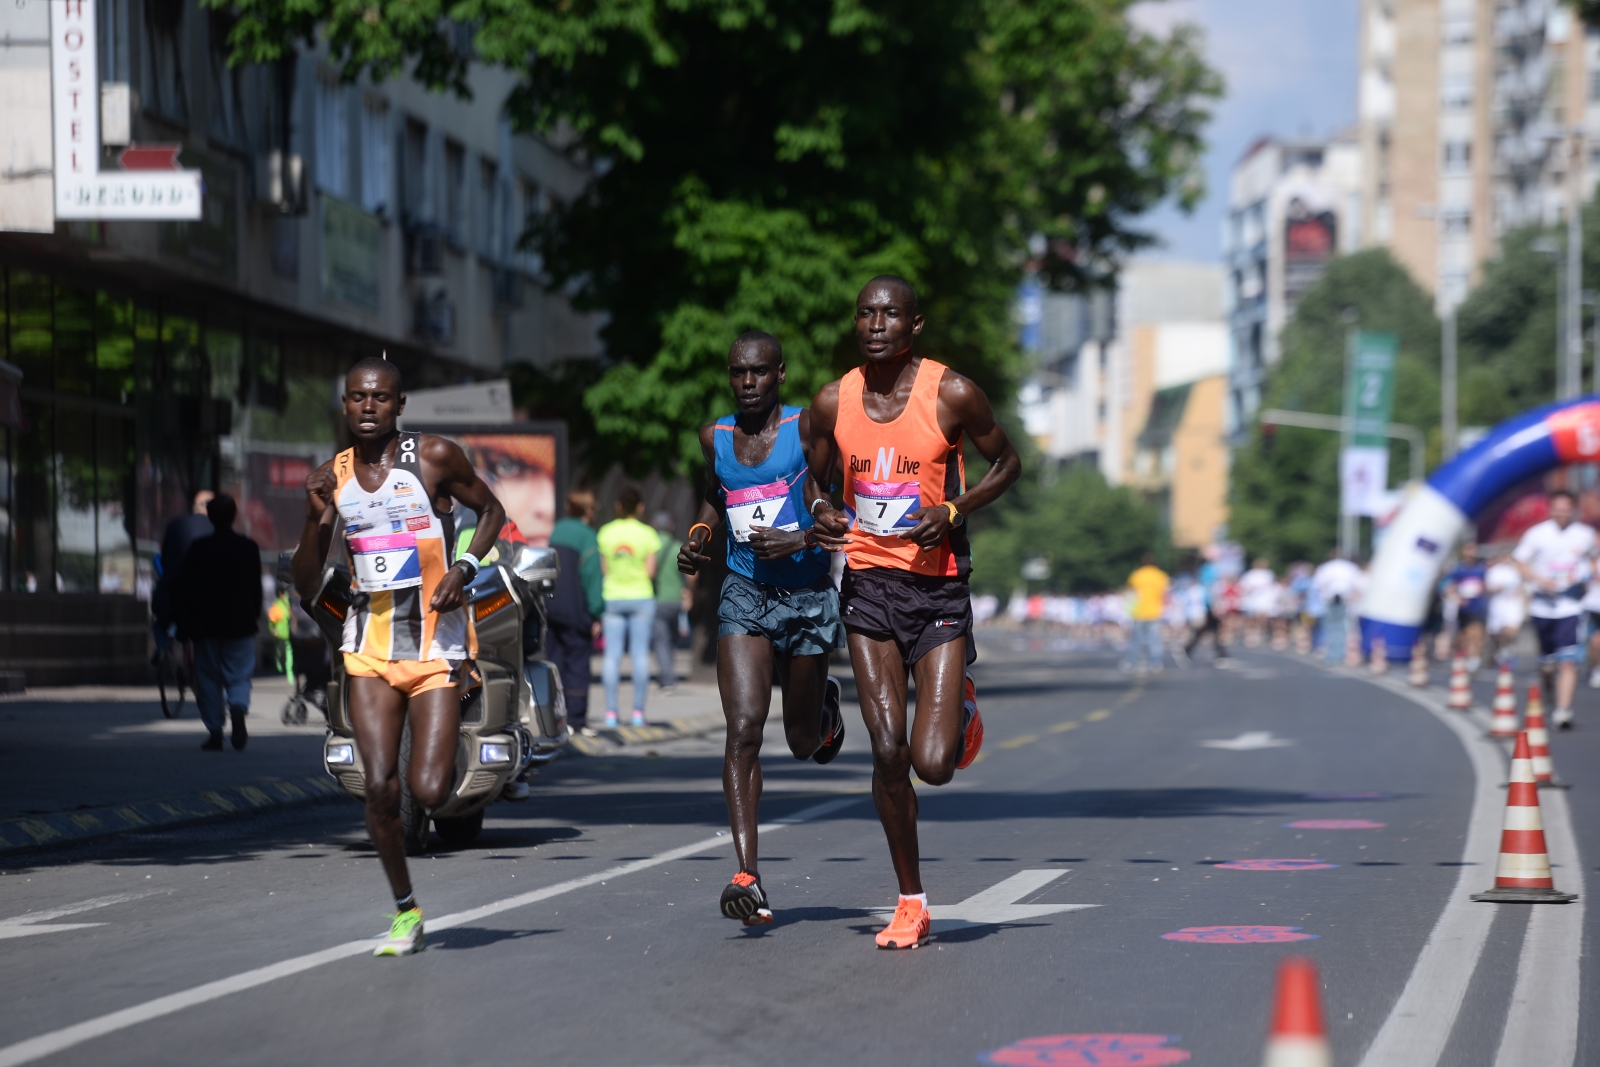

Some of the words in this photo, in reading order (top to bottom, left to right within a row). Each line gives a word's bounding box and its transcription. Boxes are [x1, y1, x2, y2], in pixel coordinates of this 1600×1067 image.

[64, 0, 84, 173] HOSTEL
[850, 454, 871, 473] Run
[873, 446, 895, 481] N
[896, 456, 920, 476] Live
[752, 505, 765, 521] 4
[875, 502, 888, 519] 7
[375, 556, 387, 573] 8
